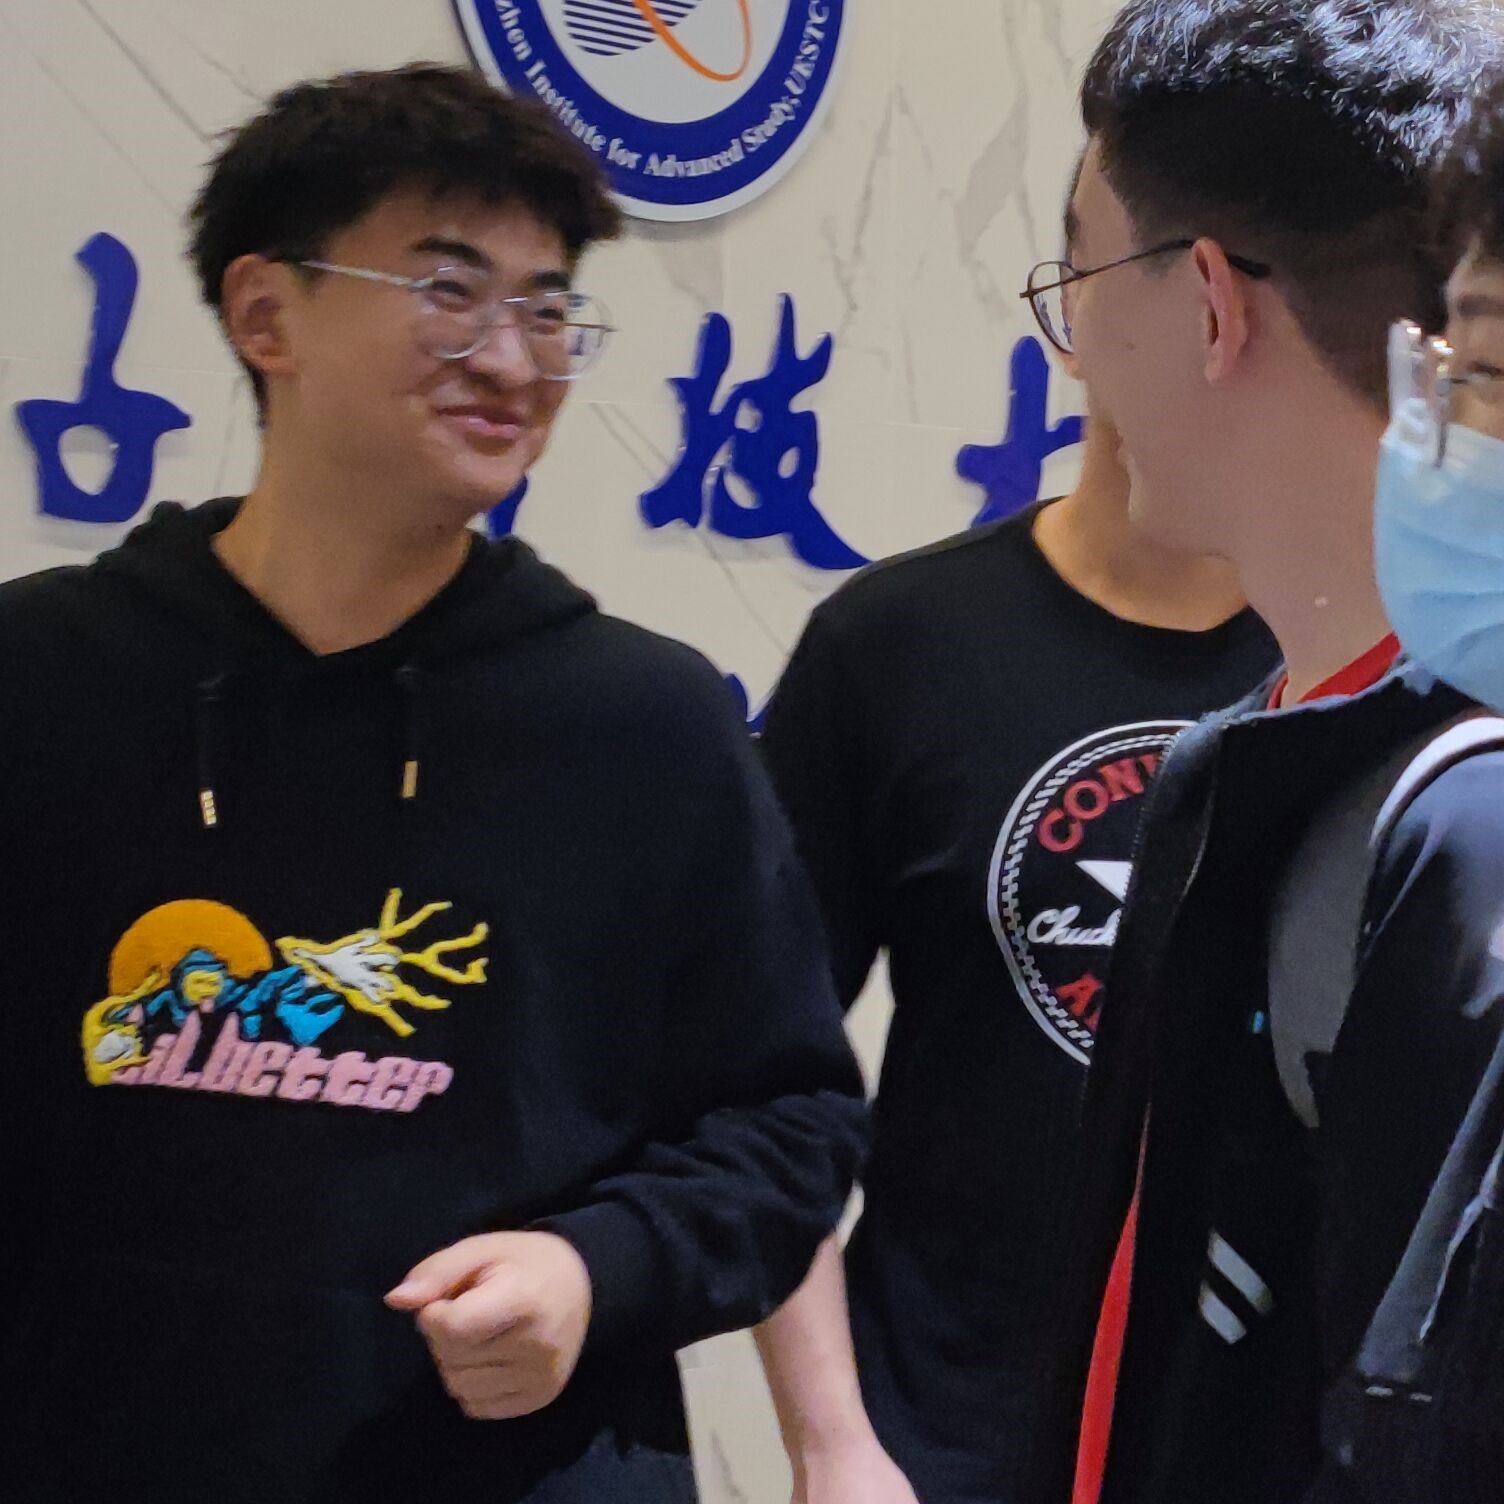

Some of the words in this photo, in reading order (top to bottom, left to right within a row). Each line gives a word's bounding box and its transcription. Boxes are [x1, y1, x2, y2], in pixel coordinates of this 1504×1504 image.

[524, 59, 607, 152] Institute
[606, 137, 642, 170] for
[643, 137, 745, 178] Advanced
